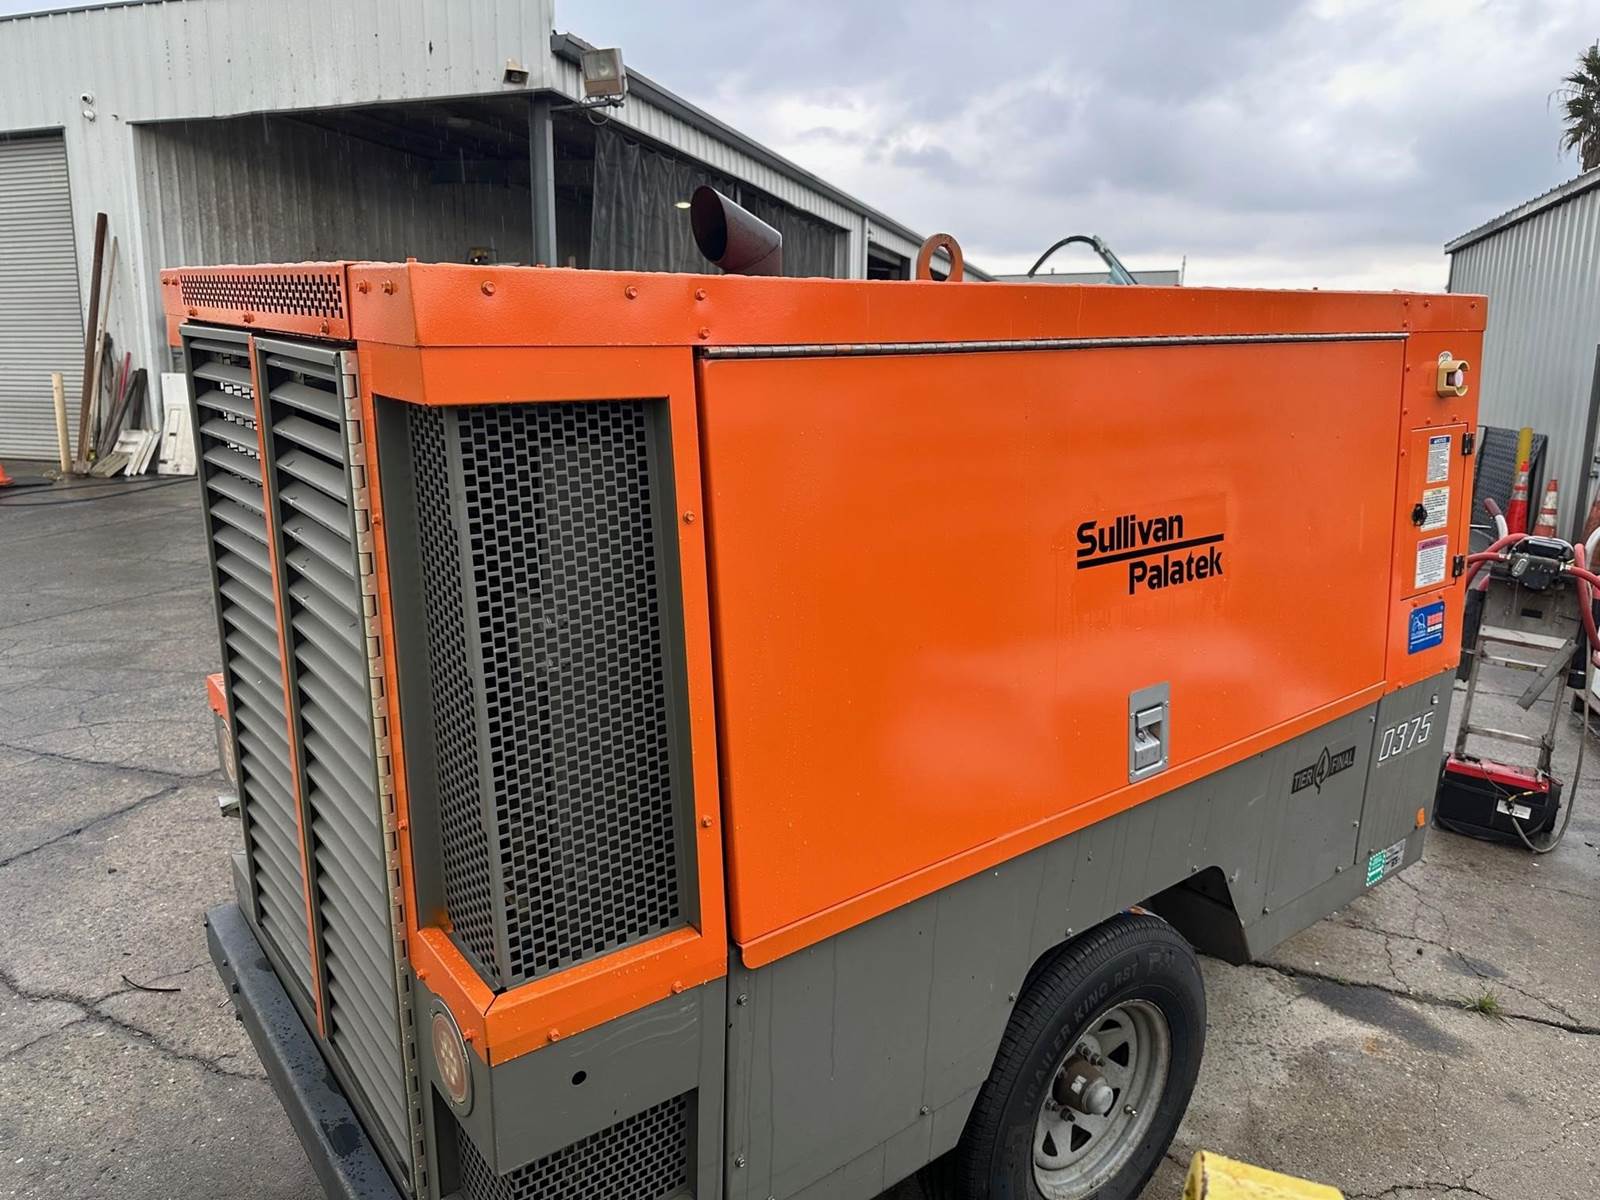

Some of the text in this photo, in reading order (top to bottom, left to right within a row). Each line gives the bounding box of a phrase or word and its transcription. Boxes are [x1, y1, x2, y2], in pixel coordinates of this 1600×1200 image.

[1076, 514, 1184, 558] Sullivan
[1129, 546, 1223, 595] Palatek
[1294, 768, 1314, 791] TIER
[1332, 749, 1354, 773] FINAL
[1073, 983, 1109, 1025] KING
